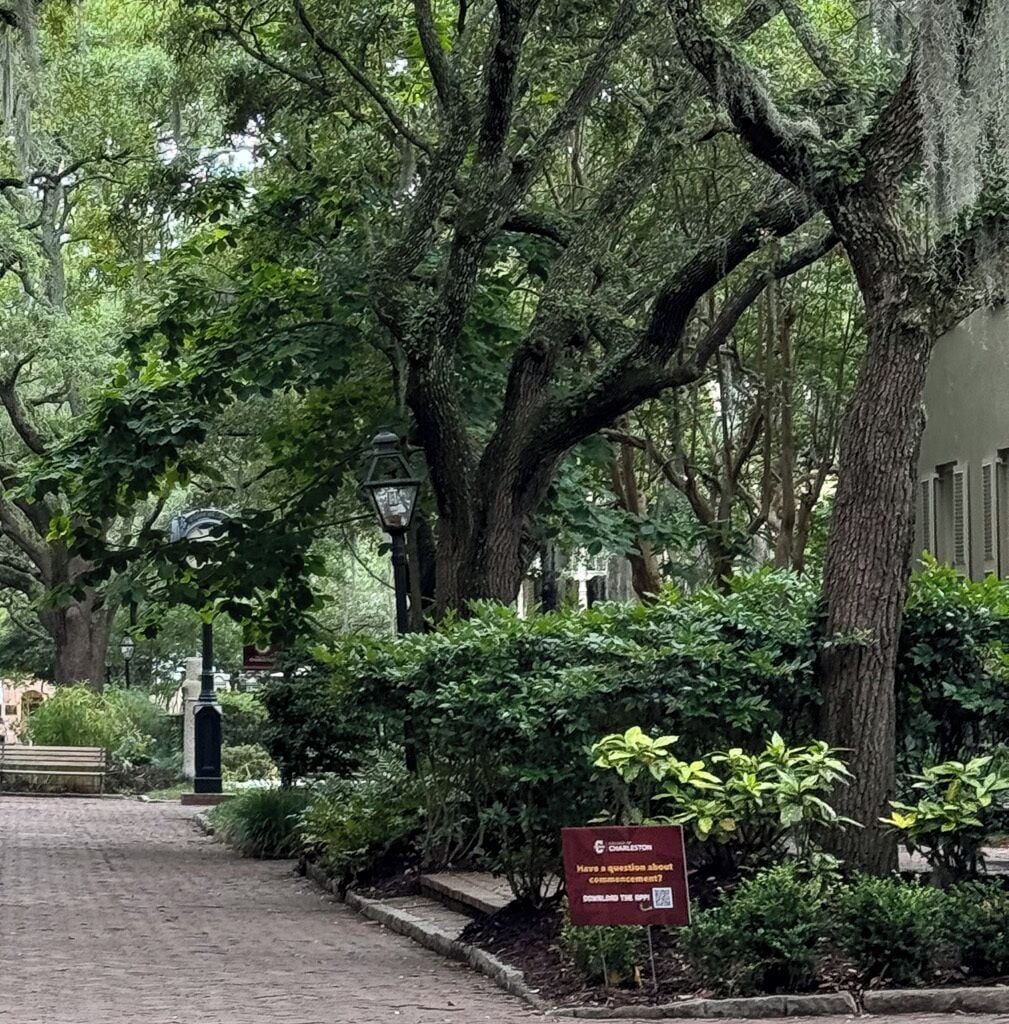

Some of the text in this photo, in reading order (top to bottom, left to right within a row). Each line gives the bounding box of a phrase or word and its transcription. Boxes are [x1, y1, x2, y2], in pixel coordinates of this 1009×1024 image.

[608, 844, 652, 852] CHARLESTON
[576, 865, 599, 873] Have
[607, 863, 646, 873] question
[647, 863, 673, 871] about
[588, 874, 663, 883] commencement?
